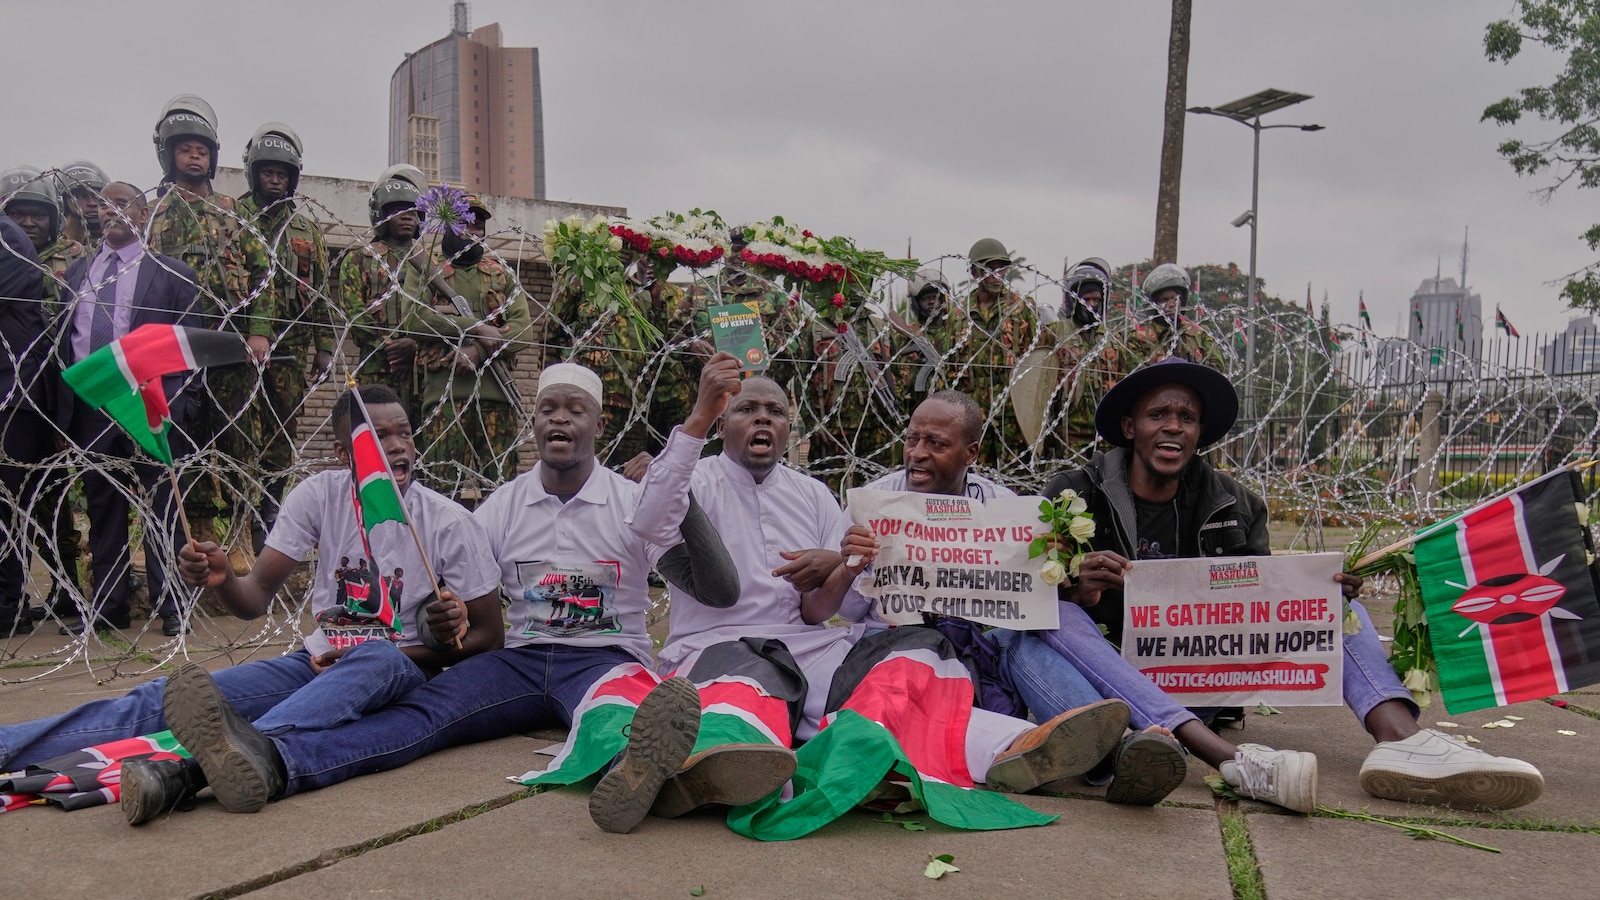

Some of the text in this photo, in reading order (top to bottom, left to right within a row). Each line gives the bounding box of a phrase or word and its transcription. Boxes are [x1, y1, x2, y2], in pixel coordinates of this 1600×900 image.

[385, 182, 420, 194] POIC
[712, 313, 757, 324] CONSTITUTION
[720, 318, 754, 329] OF KENYA
[925, 498, 950, 506] JUSTICE
[926, 504, 971, 513] MASHUJAA
[868, 519, 1033, 543] YOU CANNOT PAY US
[905, 544, 1000, 566] TO FORGET.
[1209, 560, 1257, 572] JUSTICE 4 OUR
[539, 573, 594, 586] JUNE 25th
[873, 564, 1033, 593] KENYA, REMEMBER
[1210, 567, 1259, 582] MASHUJAA
[879, 593, 1026, 620] YOUR CHILDREN.
[1130, 598, 1335, 628] WE GATHER IN GRIEF,
[1136, 629, 1334, 657] WE MARCH IN HOPE!
